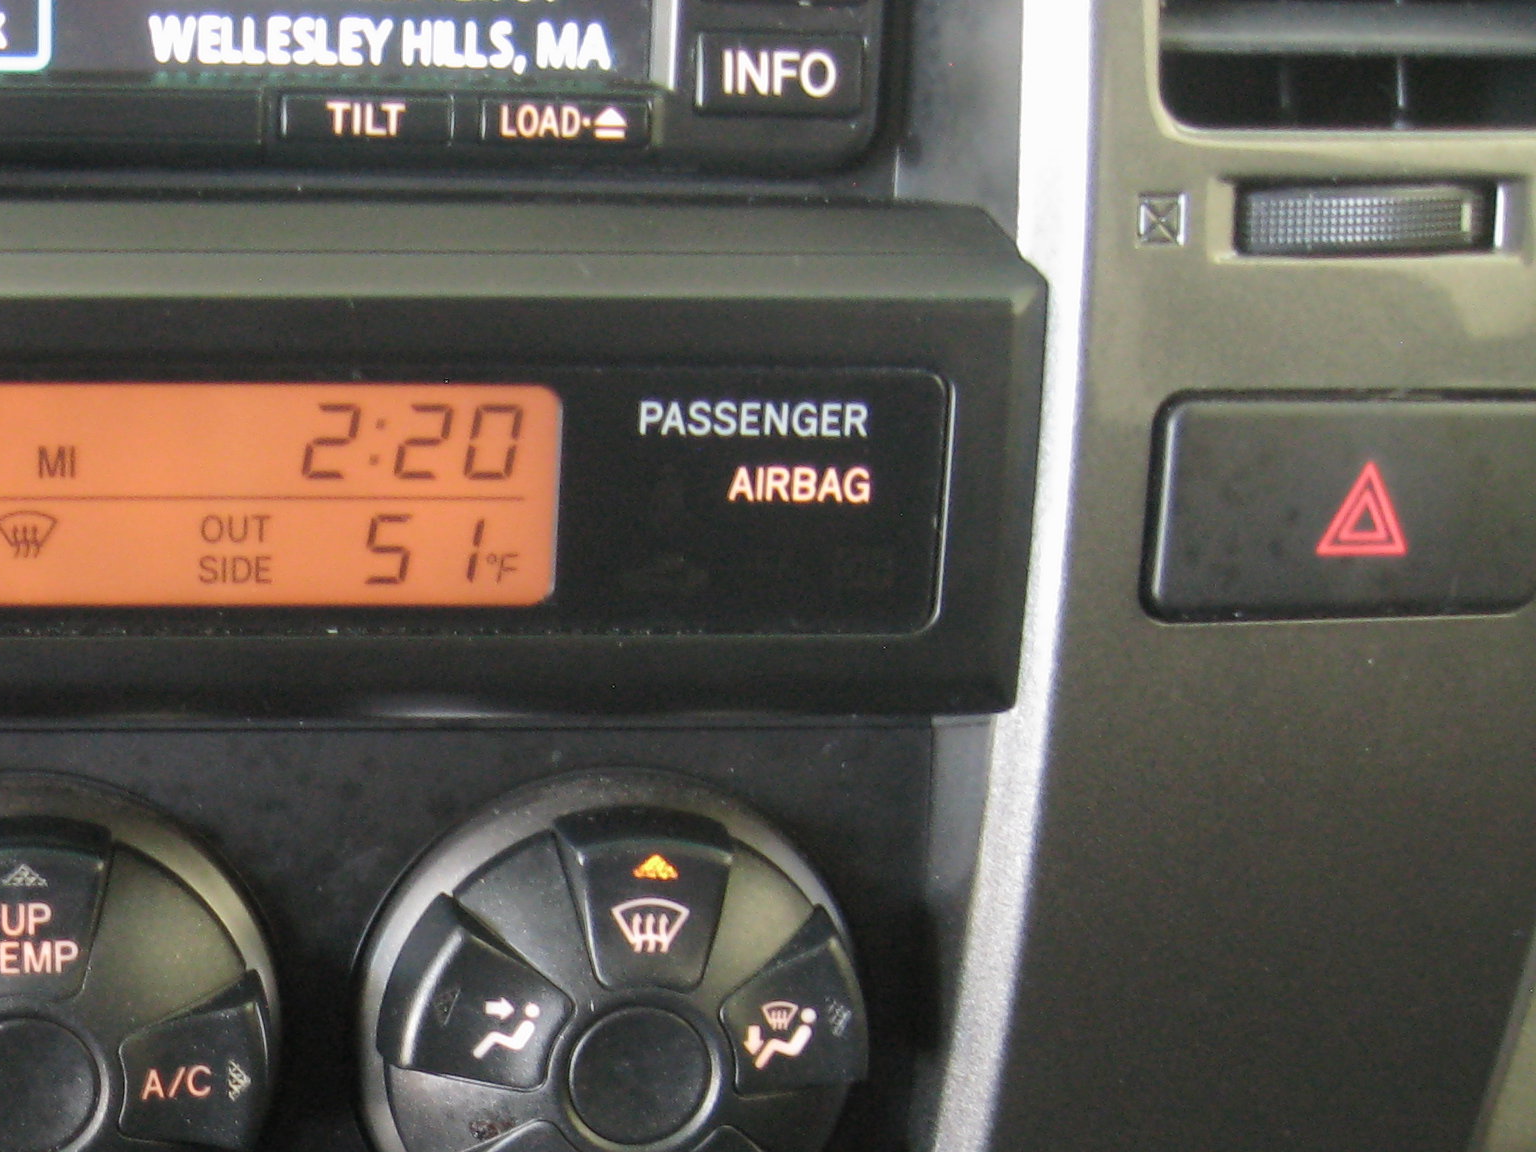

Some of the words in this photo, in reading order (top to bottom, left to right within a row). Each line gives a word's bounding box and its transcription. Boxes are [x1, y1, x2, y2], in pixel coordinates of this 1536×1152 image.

[148, 14, 394, 66] WELLESLEY
[401, 18, 527, 75] HILLS,
[536, 21, 613, 71] MA
[722, 49, 836, 97] INFO
[325, 101, 407, 137] TILT
[638, 401, 869, 438] PASSENGER
[301, 403, 526, 481] 2:20
[37, 445, 78, 480] MI
[728, 466, 872, 504] AIRBAG
[199, 514, 272, 545] OUT
[198, 554, 273, 586] SIDE
[141, 1064, 213, 1100] A/C
